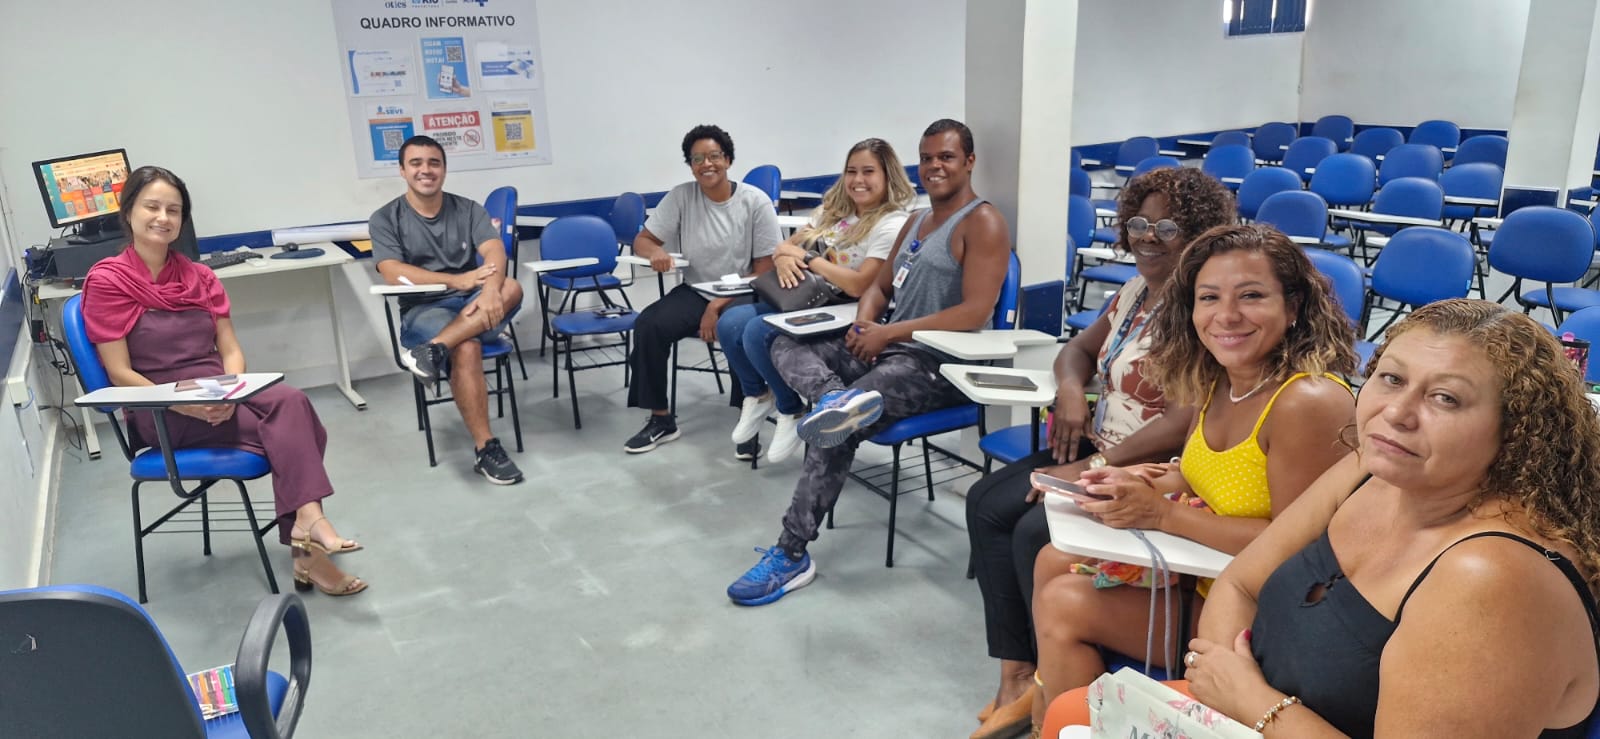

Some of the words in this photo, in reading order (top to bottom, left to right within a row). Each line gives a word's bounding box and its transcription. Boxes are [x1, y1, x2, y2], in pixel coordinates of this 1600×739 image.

[360, 17, 421, 29] QUADRO
[425, 15, 515, 28] INFORMATIVO
[429, 113, 475, 128] ATENÇÃO
